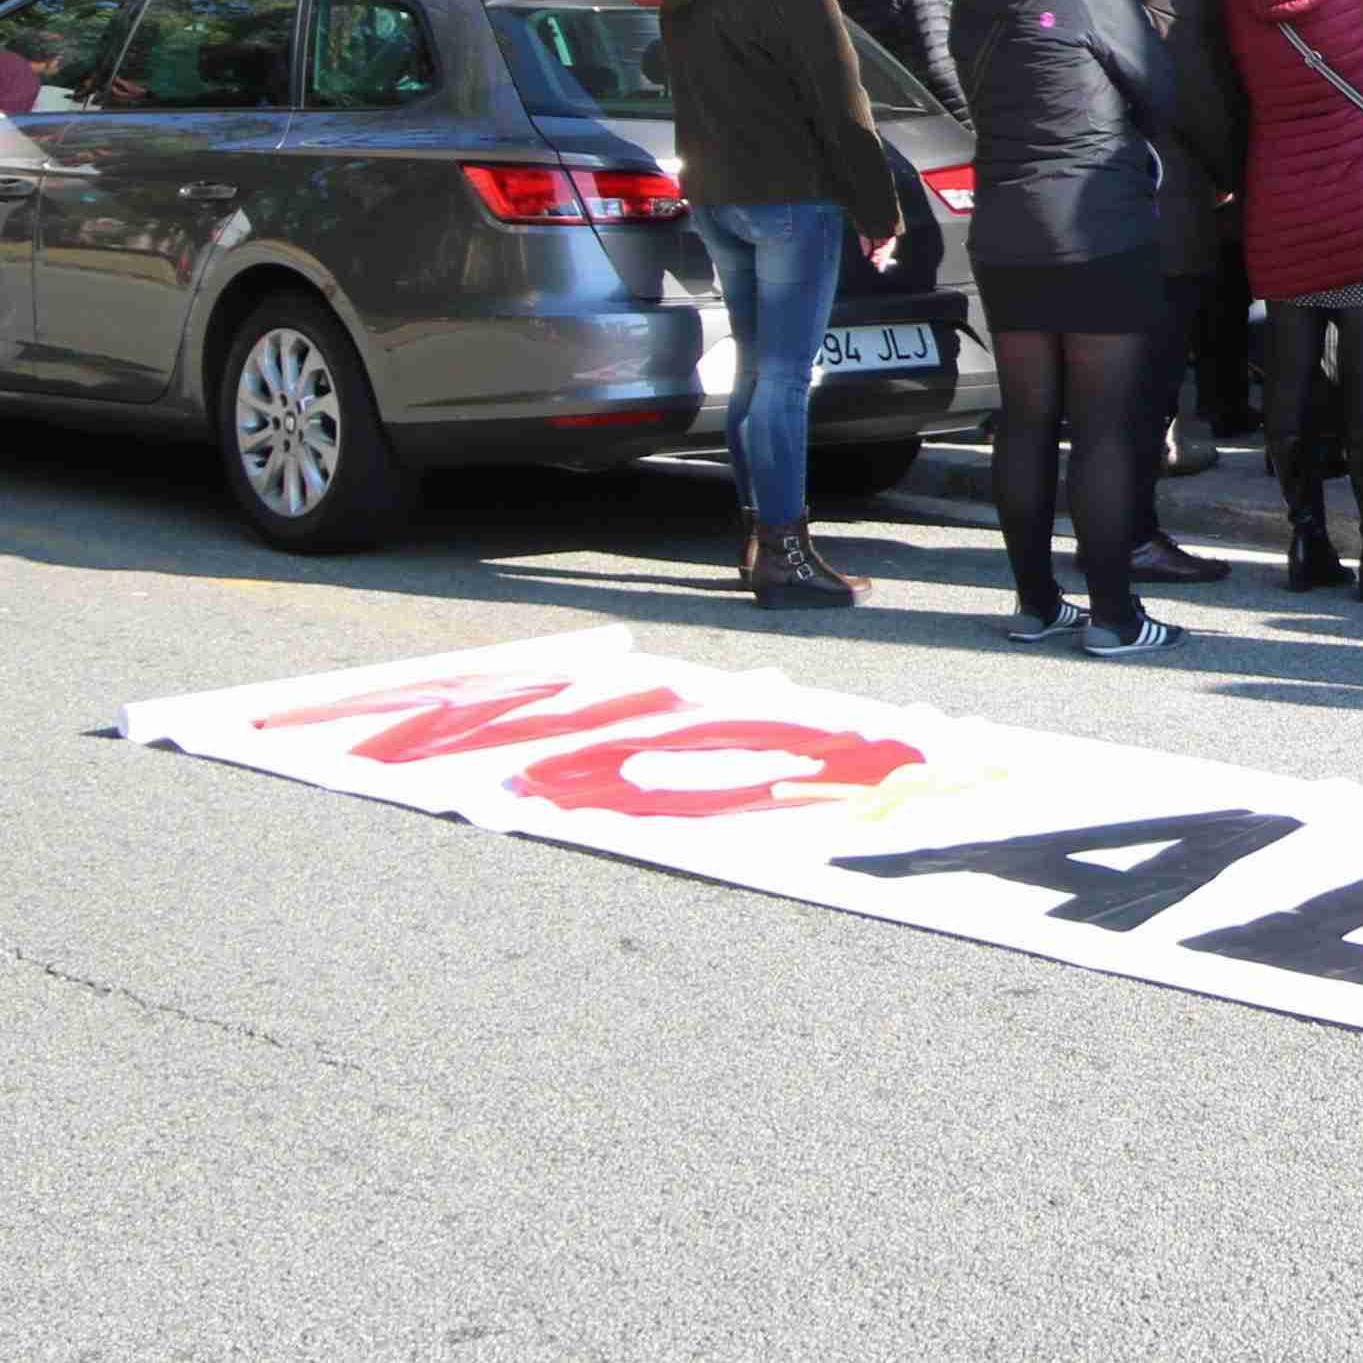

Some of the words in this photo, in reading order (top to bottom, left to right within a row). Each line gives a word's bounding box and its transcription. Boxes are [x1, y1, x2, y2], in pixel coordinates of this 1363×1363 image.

[819, 332, 862, 365] 94
[878, 326, 928, 361] JLJ
[250, 672, 927, 818] NO
